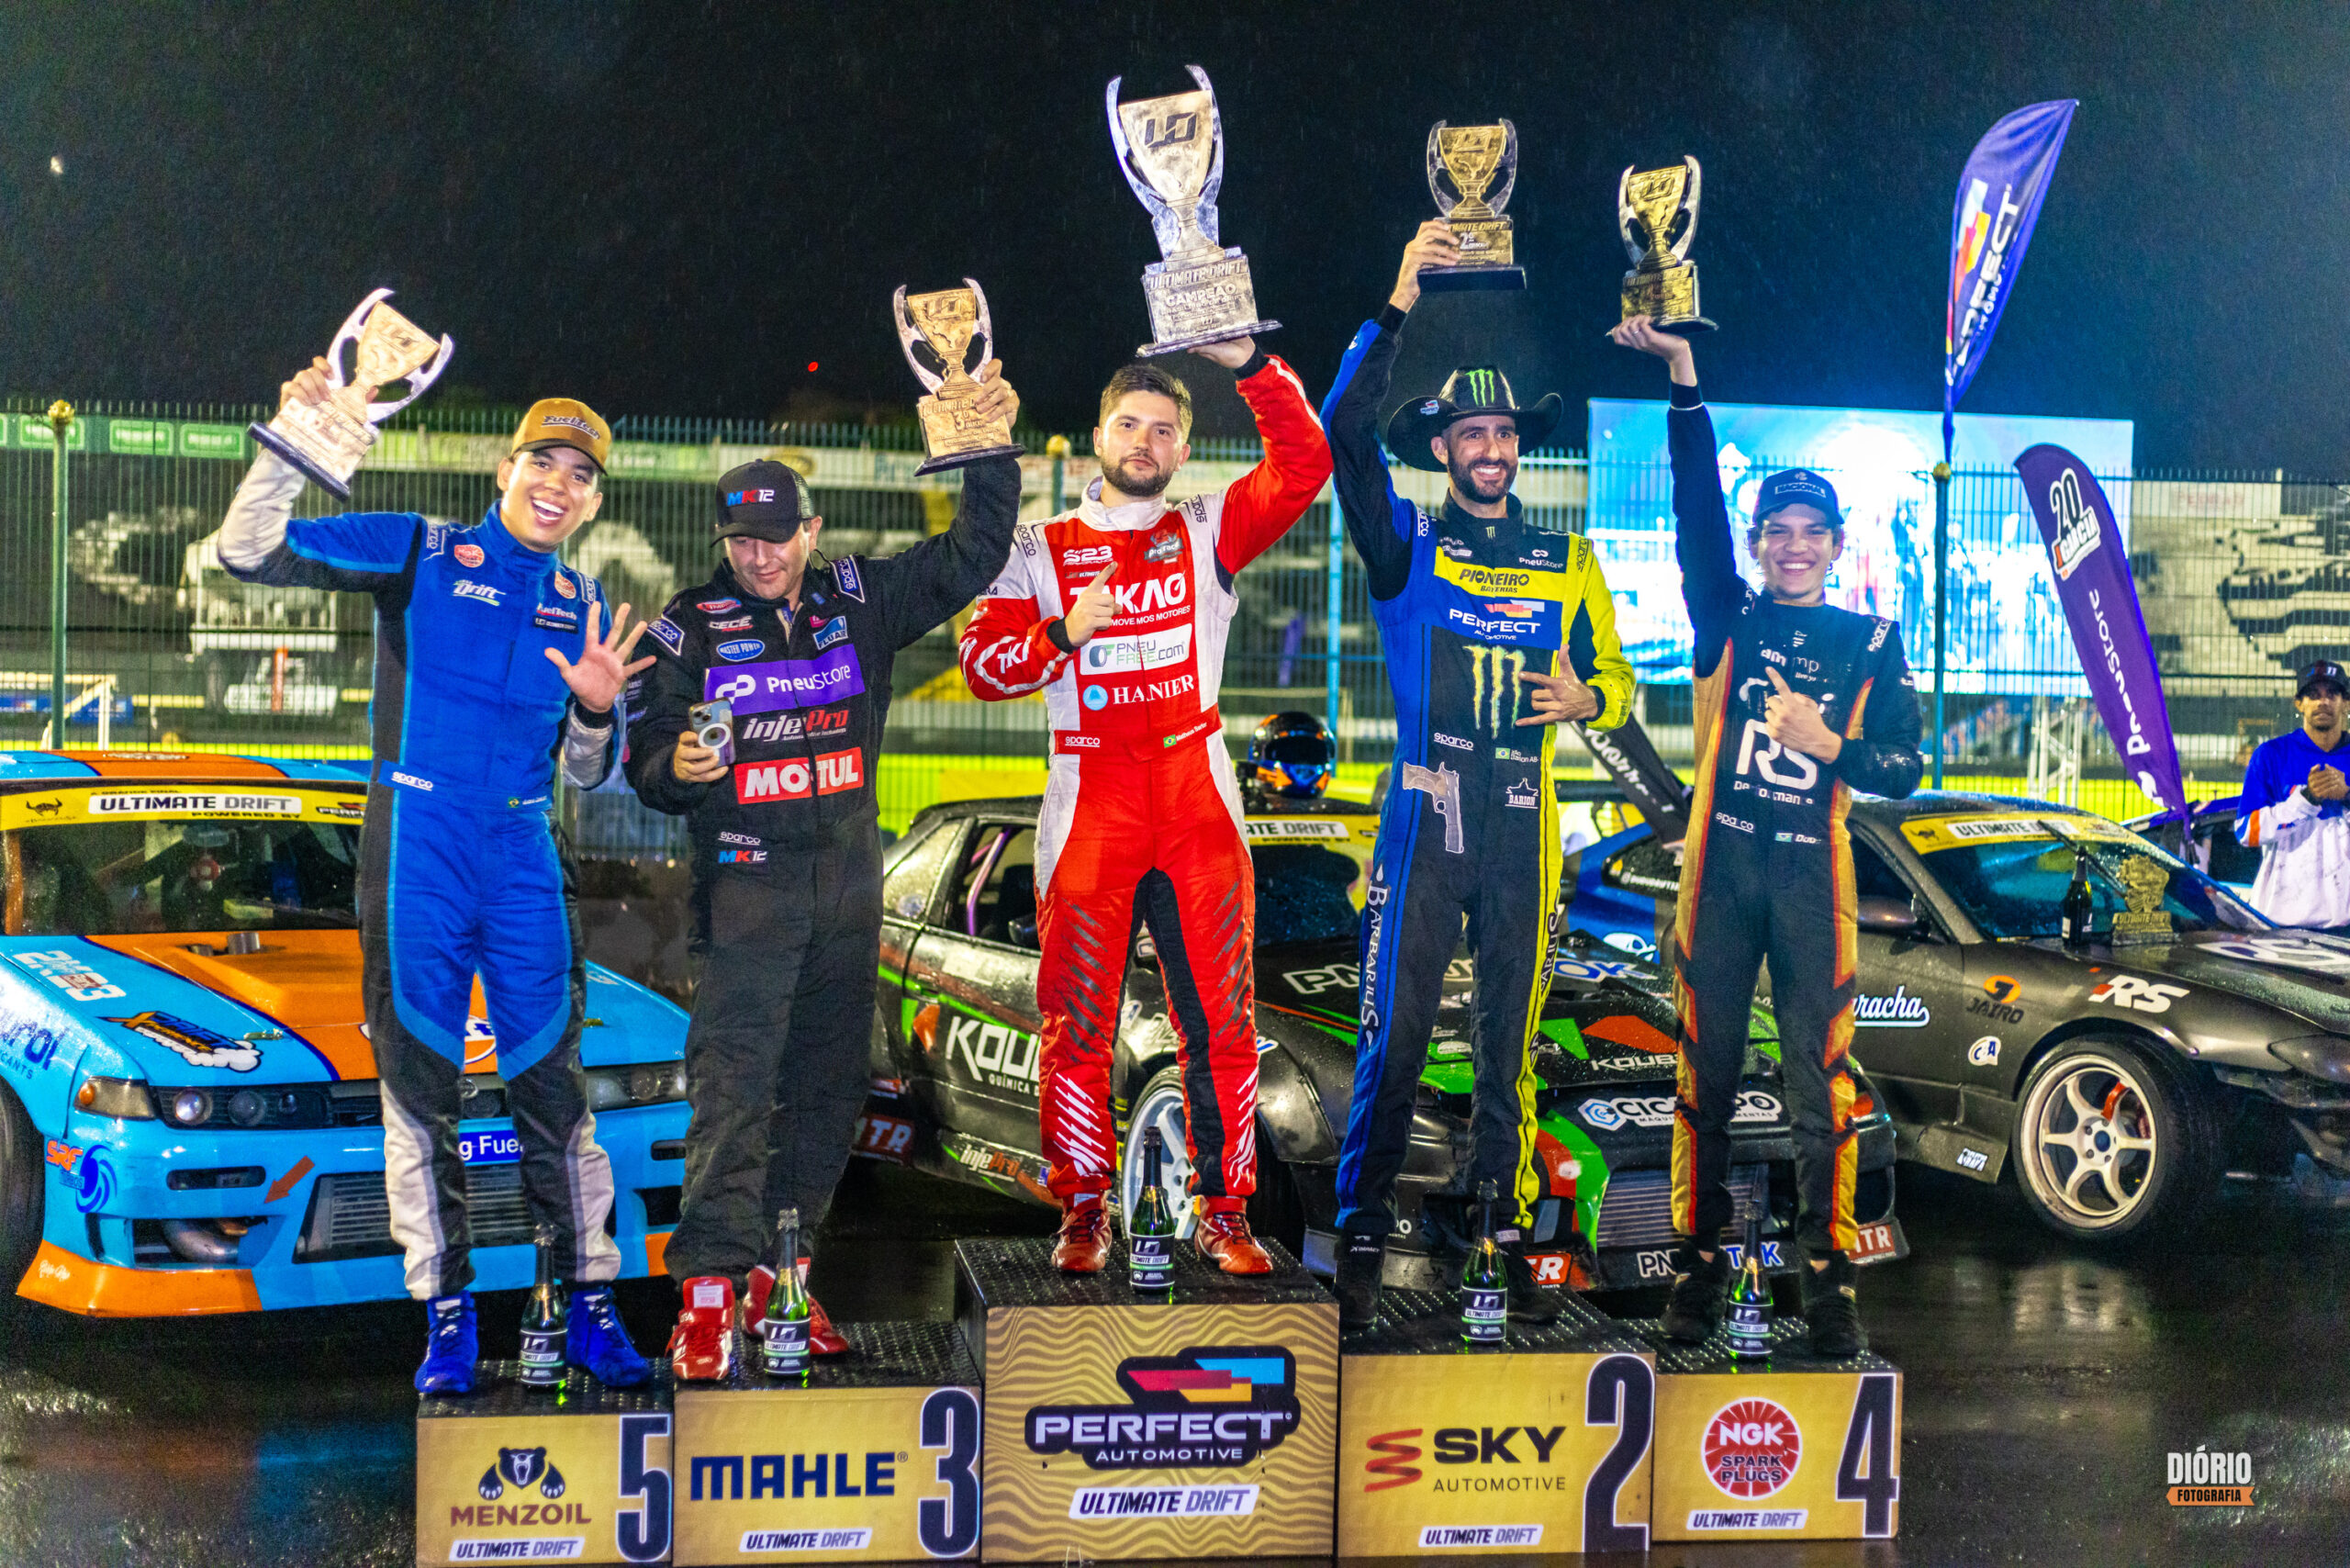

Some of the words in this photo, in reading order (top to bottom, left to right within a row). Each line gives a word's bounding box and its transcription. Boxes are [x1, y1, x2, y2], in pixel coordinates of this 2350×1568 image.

[2051, 468, 2082, 532] 20
[1459, 568, 1529, 586] PIONEIRO
[1449, 608, 1541, 634] PERFECT
[1112, 674, 1195, 704] HANIER
[1065, 735, 1101, 748] sparco
[1434, 732, 1474, 751] sparco
[392, 771, 434, 791] sparco
[744, 756, 859, 798] MOTUL
[100, 796, 217, 811] ULTIMATE
[225, 797, 293, 811] DRIFT
[1283, 823, 1337, 834] DRIFT
[1715, 811, 1754, 834] spaco
[718, 831, 762, 846] sparco
[946, 1016, 1043, 1082] KOU
[989, 1073, 1031, 1094] QUÍMICA
[1035, 1412, 1284, 1444] PERFECT
[1719, 1422, 1784, 1446] NGK
[1095, 1449, 1243, 1462] AUTOMOTIVE
[1434, 1427, 1567, 1463] SKY
[1583, 1353, 1655, 1553] 2
[1835, 1373, 1899, 1538] 4
[1722, 1455, 1782, 1467] SPARK
[918, 1386, 980, 1558] 3
[1722, 1470, 1782, 1483] PLUGS
[615, 1413, 673, 1562] 5
[1433, 1477, 1566, 1493] AUTOMOTIVE
[1079, 1491, 1182, 1515] ULTIMATE
[1185, 1490, 1250, 1513] DRIFT
[450, 1503, 592, 1527] MENZOIL
[1694, 1513, 1759, 1528] ULTIMATE
[1761, 1512, 1803, 1527] DRIFT
[746, 1532, 819, 1550] ULTIMATE
[820, 1531, 866, 1548] DRIFT
[1426, 1529, 1492, 1545] ULTIMATE
[1494, 1528, 1539, 1544] DRIFT
[456, 1540, 531, 1558] ULTIMATE
[532, 1540, 578, 1557] DRIFT
